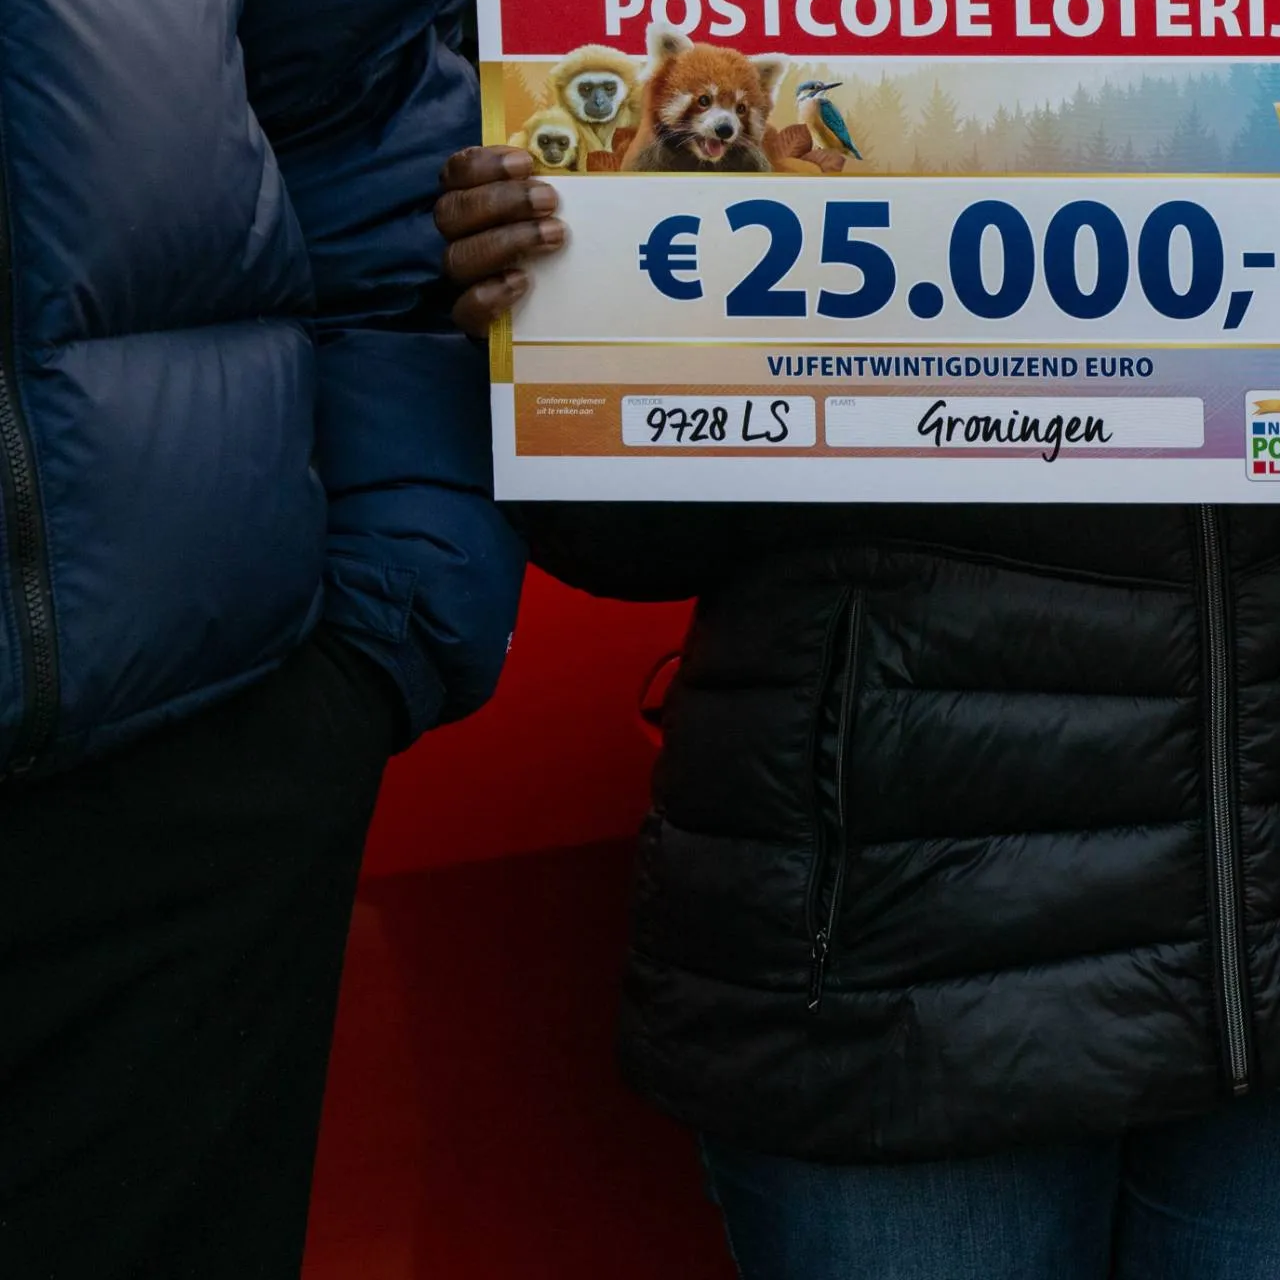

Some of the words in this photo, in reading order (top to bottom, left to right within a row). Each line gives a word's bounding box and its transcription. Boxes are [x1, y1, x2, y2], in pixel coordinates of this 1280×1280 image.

[767, 356, 1079, 378] VIJFENTWINTIGDUIZEND
[1086, 357, 1154, 378] EURO
[646, 407, 728, 442] 9728
[742, 400, 790, 443] LS
[917, 400, 1113, 463] Groningen
